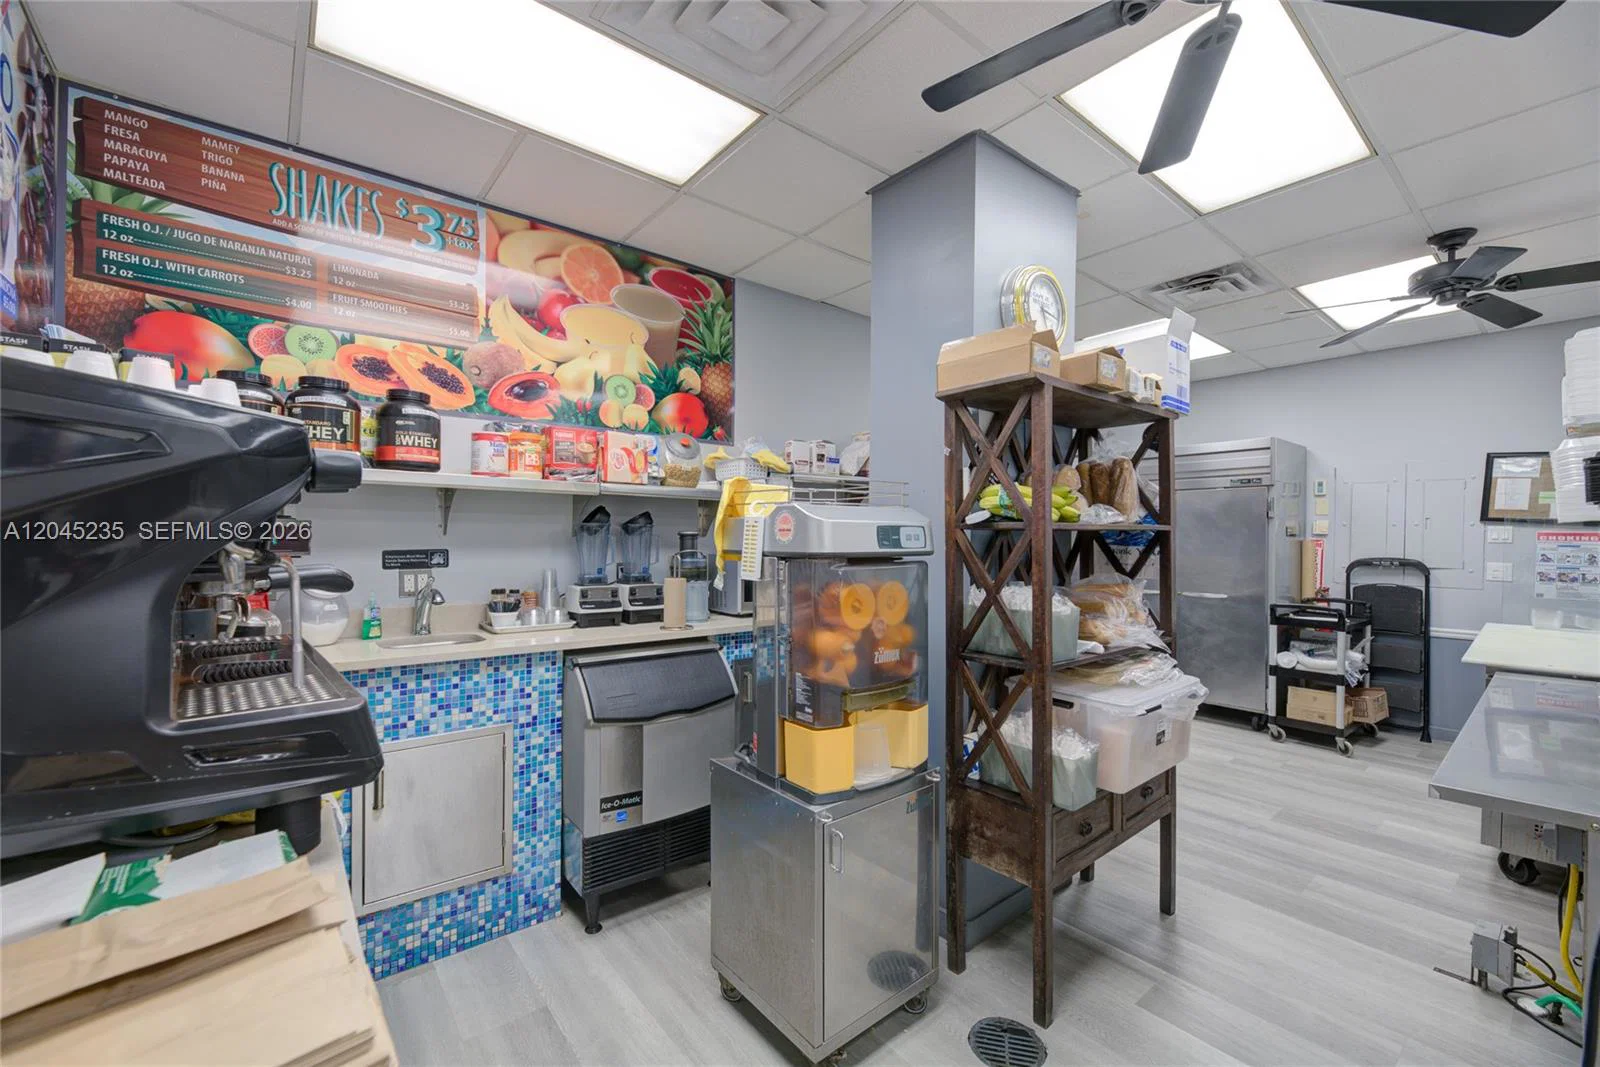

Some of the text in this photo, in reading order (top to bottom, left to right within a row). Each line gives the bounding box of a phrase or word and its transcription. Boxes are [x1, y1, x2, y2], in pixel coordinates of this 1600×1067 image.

[104, 109, 149, 129] MANGO
[104, 124, 140, 141] FRESA
[104, 138, 168, 163] MARACUYA
[201, 136, 240, 154] MAMEY
[103, 152, 150, 173] PAPAYA
[201, 150, 233, 166] TRIGO
[103, 168, 166, 191] MALTEADA
[201, 164, 245, 183] BANANA
[201, 177, 227, 192] PIÑA
[268, 161, 385, 241] SHAKES
[102, 213, 139, 230] FRESH
[143, 221, 163, 235] O.J.
[172, 229, 201, 243] JUGO
[203, 235, 217, 246] DE
[219, 238, 267, 258] NARANJA
[268, 249, 313, 267] NATURAL
[102, 228, 312, 279] 12 oz $3.25
[102, 248, 245, 285] FRESH O.J. WITH CARROTS
[332, 263, 380, 281] LIMONADA
[102, 264, 312, 310] 12 oz $4.00
[333, 275, 345, 285] 12
[332, 293, 408, 315] FRUIT SMOOTHIES
[0, 336, 28, 345] STASH
[400, 434, 438, 449] WHEY
[601, 795, 641, 810] Ice-O-Matic
